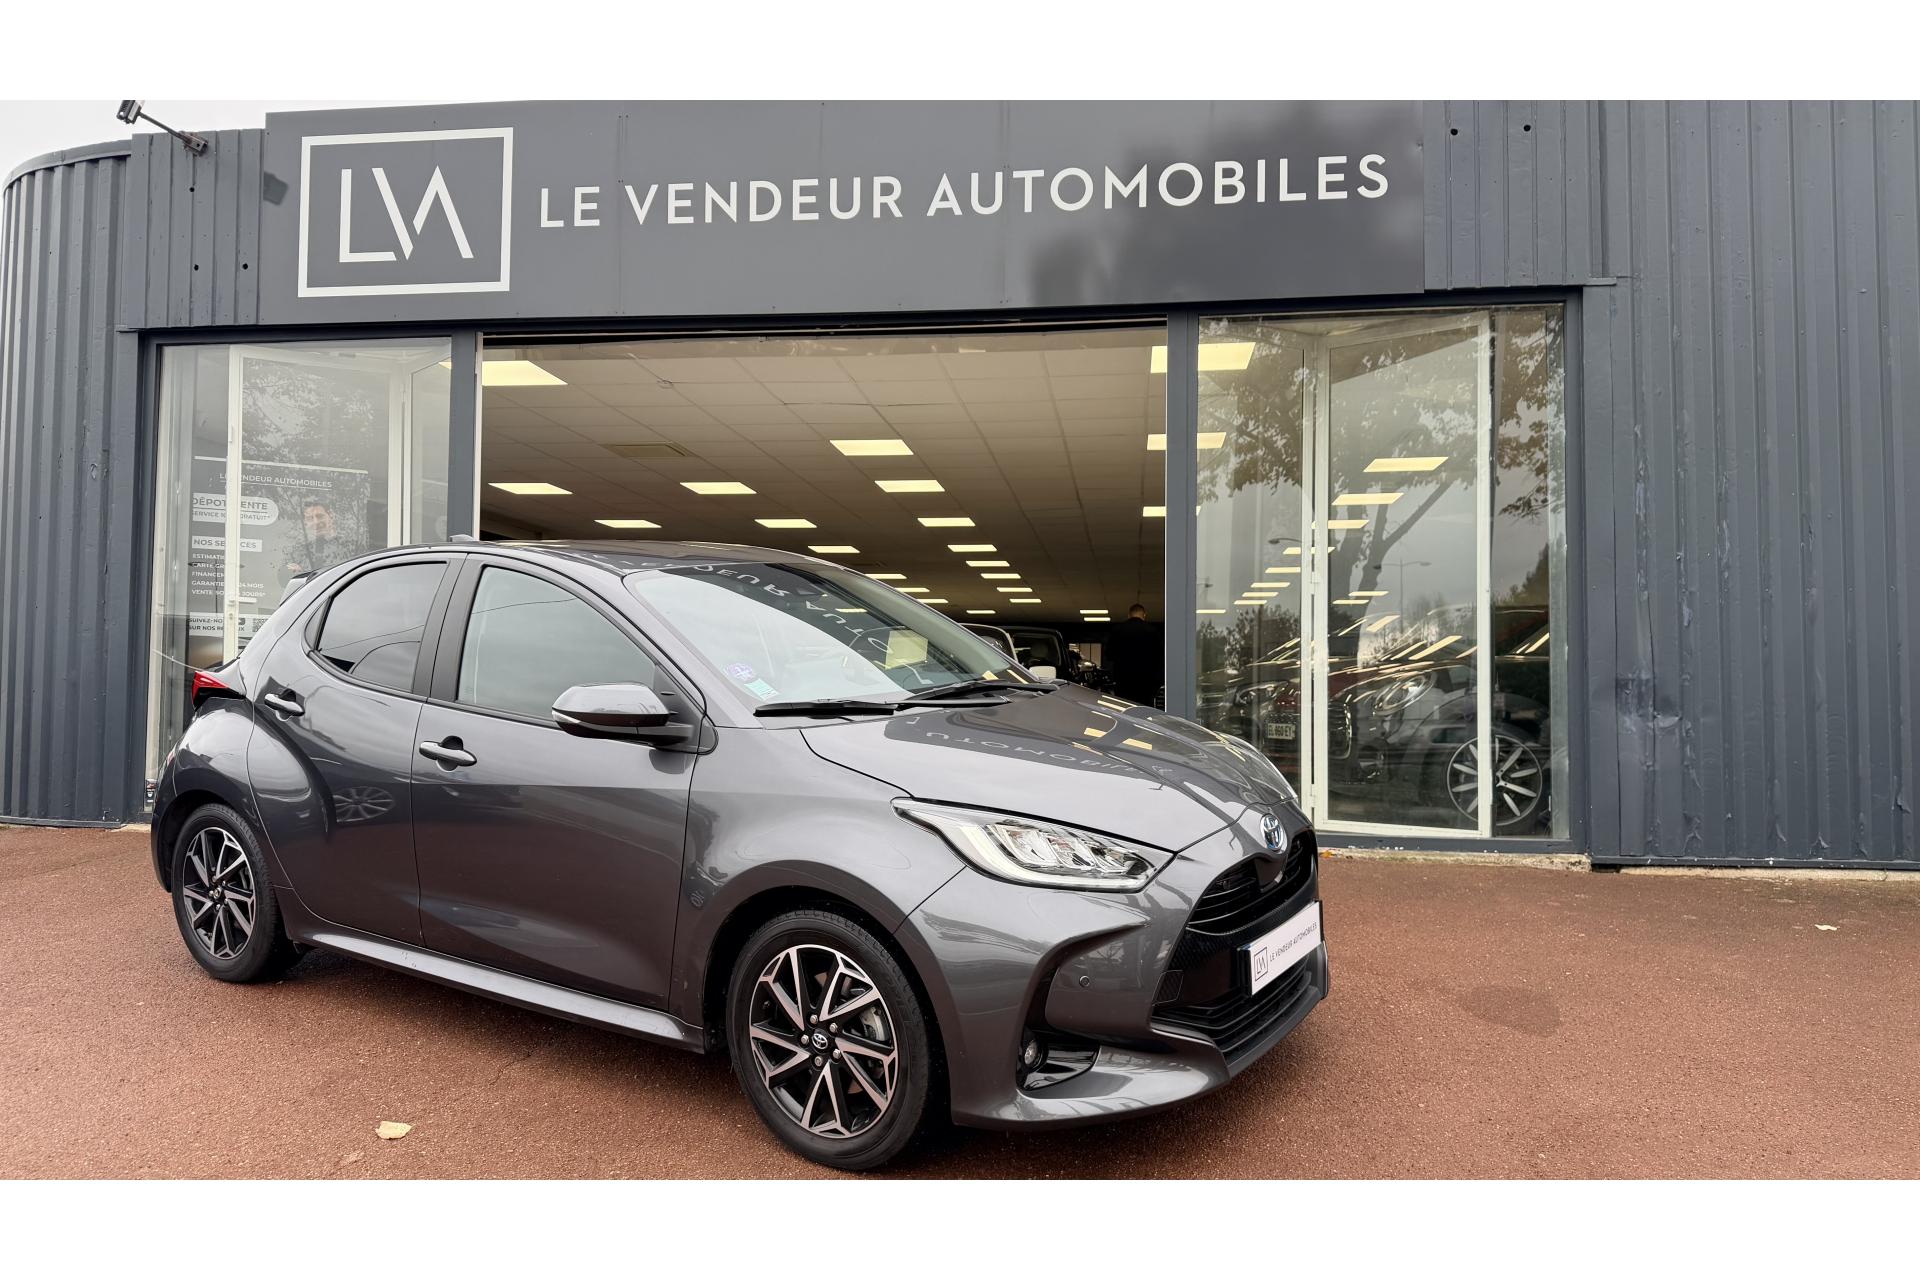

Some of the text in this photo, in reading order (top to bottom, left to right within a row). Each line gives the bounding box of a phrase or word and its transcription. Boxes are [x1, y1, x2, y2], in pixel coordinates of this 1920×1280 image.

[540, 153, 1390, 228] LE VENDEUR AUTOMOBILES
[274, 477, 332, 488] AUTOMOBILES
[240, 501, 268, 510] ENTE
